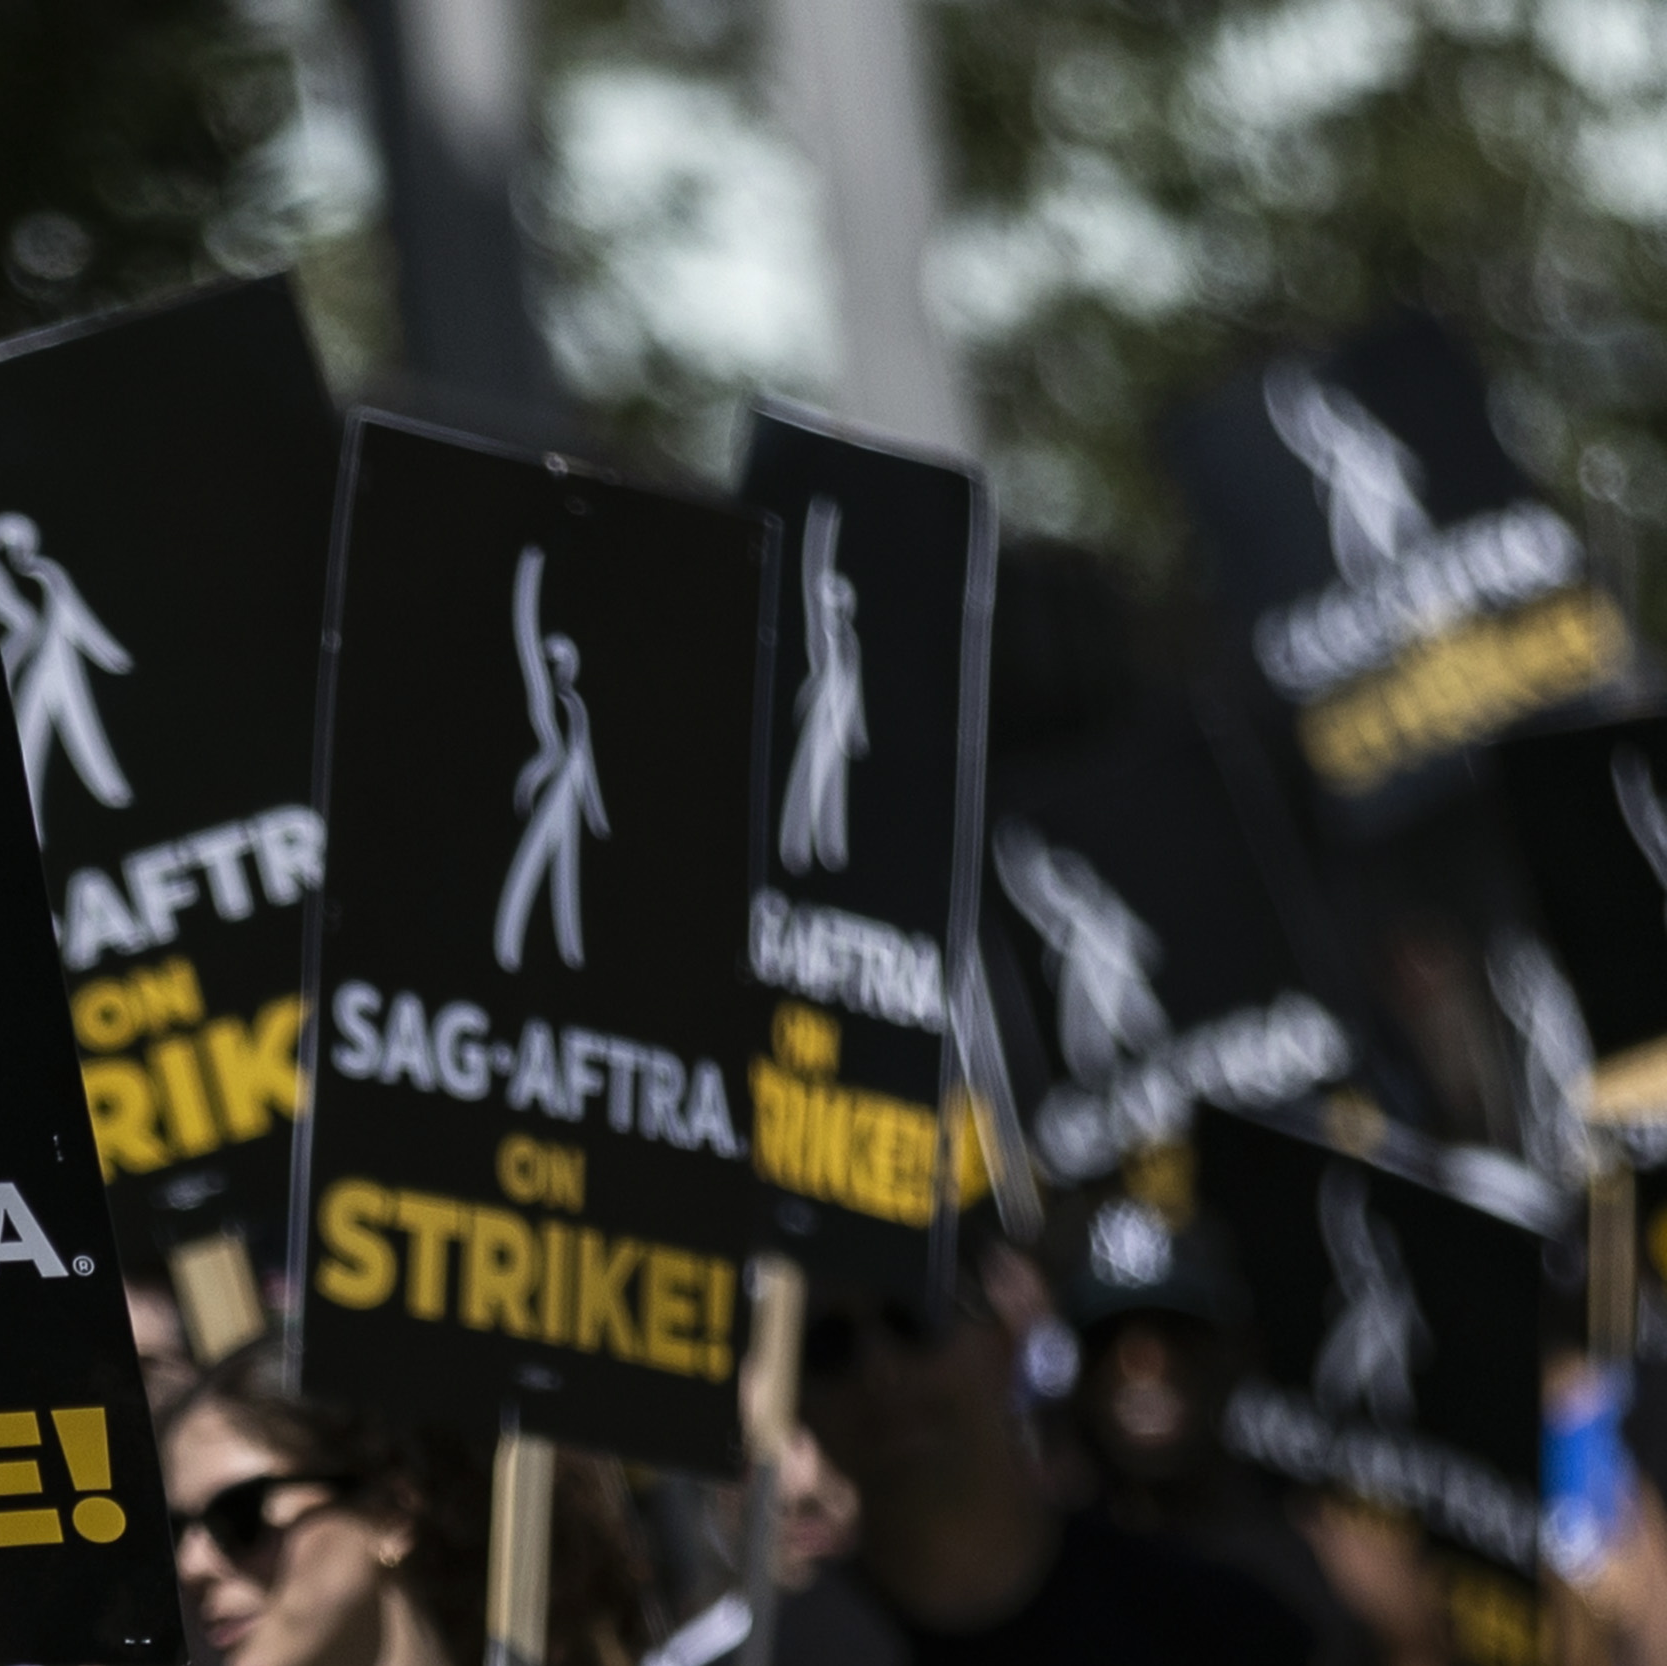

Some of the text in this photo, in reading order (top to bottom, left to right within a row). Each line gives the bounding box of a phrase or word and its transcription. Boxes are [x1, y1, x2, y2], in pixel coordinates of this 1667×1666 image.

[68, 956, 204, 1053] ON
[495, 1133, 586, 1212] ON
[315, 1177, 737, 1384] STRIKE!
